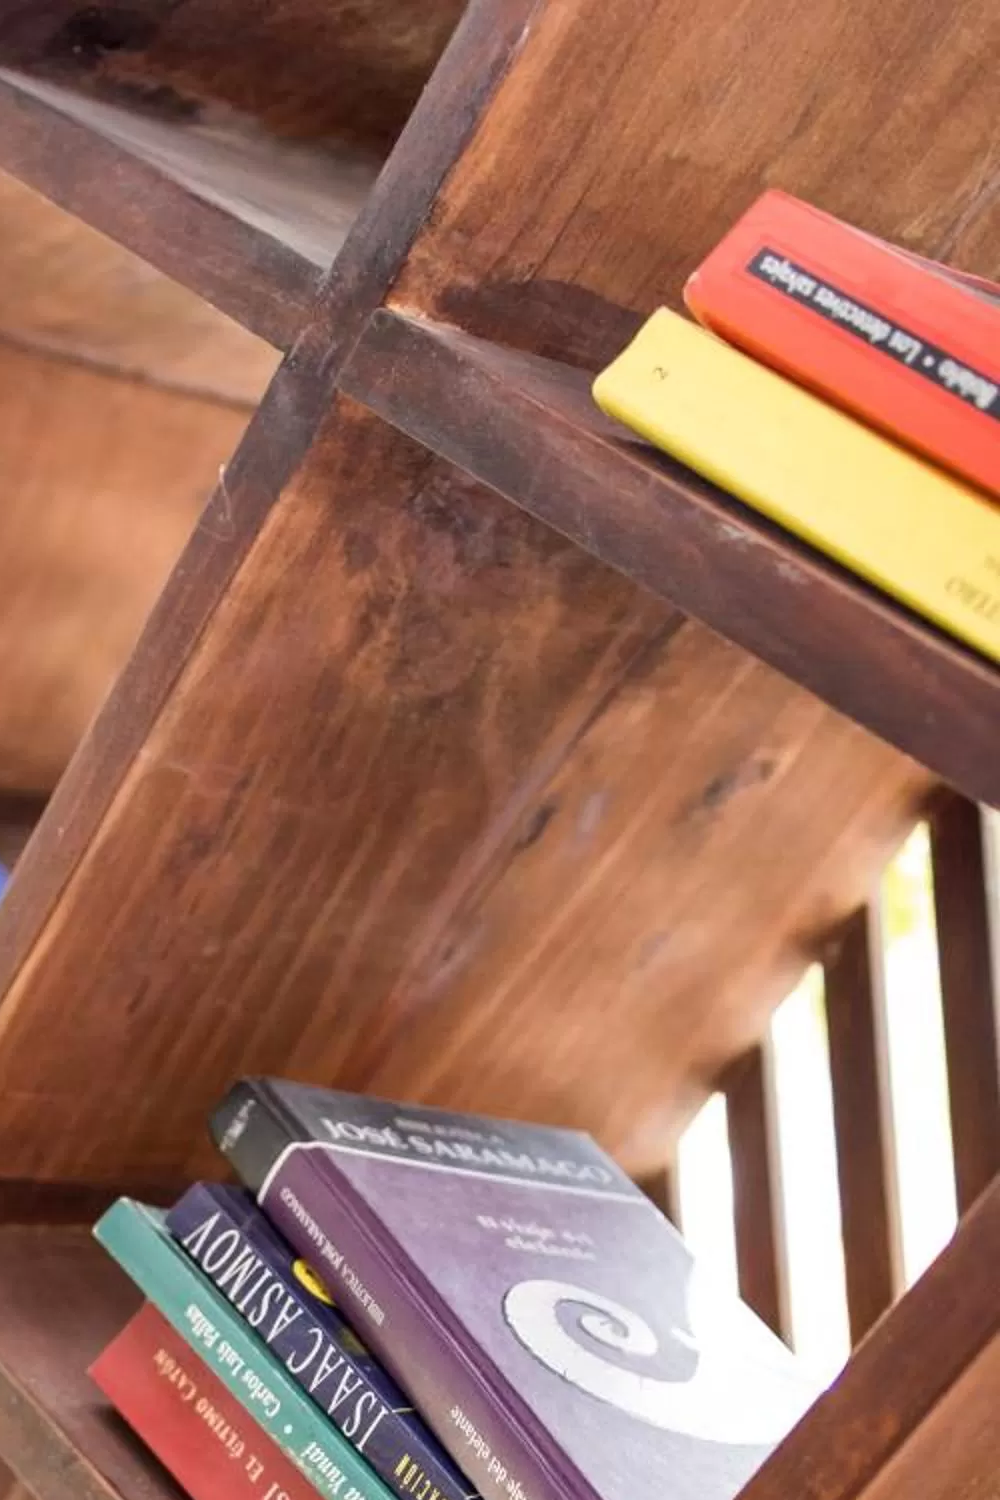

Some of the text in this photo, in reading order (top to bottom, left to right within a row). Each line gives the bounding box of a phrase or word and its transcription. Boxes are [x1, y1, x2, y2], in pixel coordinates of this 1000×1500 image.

[181, 1214, 390, 1452] ISAAC ASIMOV
[183, 1302, 281, 1418] Carlos Luis Fallas
[445, 1404, 491, 1460] elefante
[303, 1440, 347, 1495] Yunai
[486, 1455, 507, 1484] del
